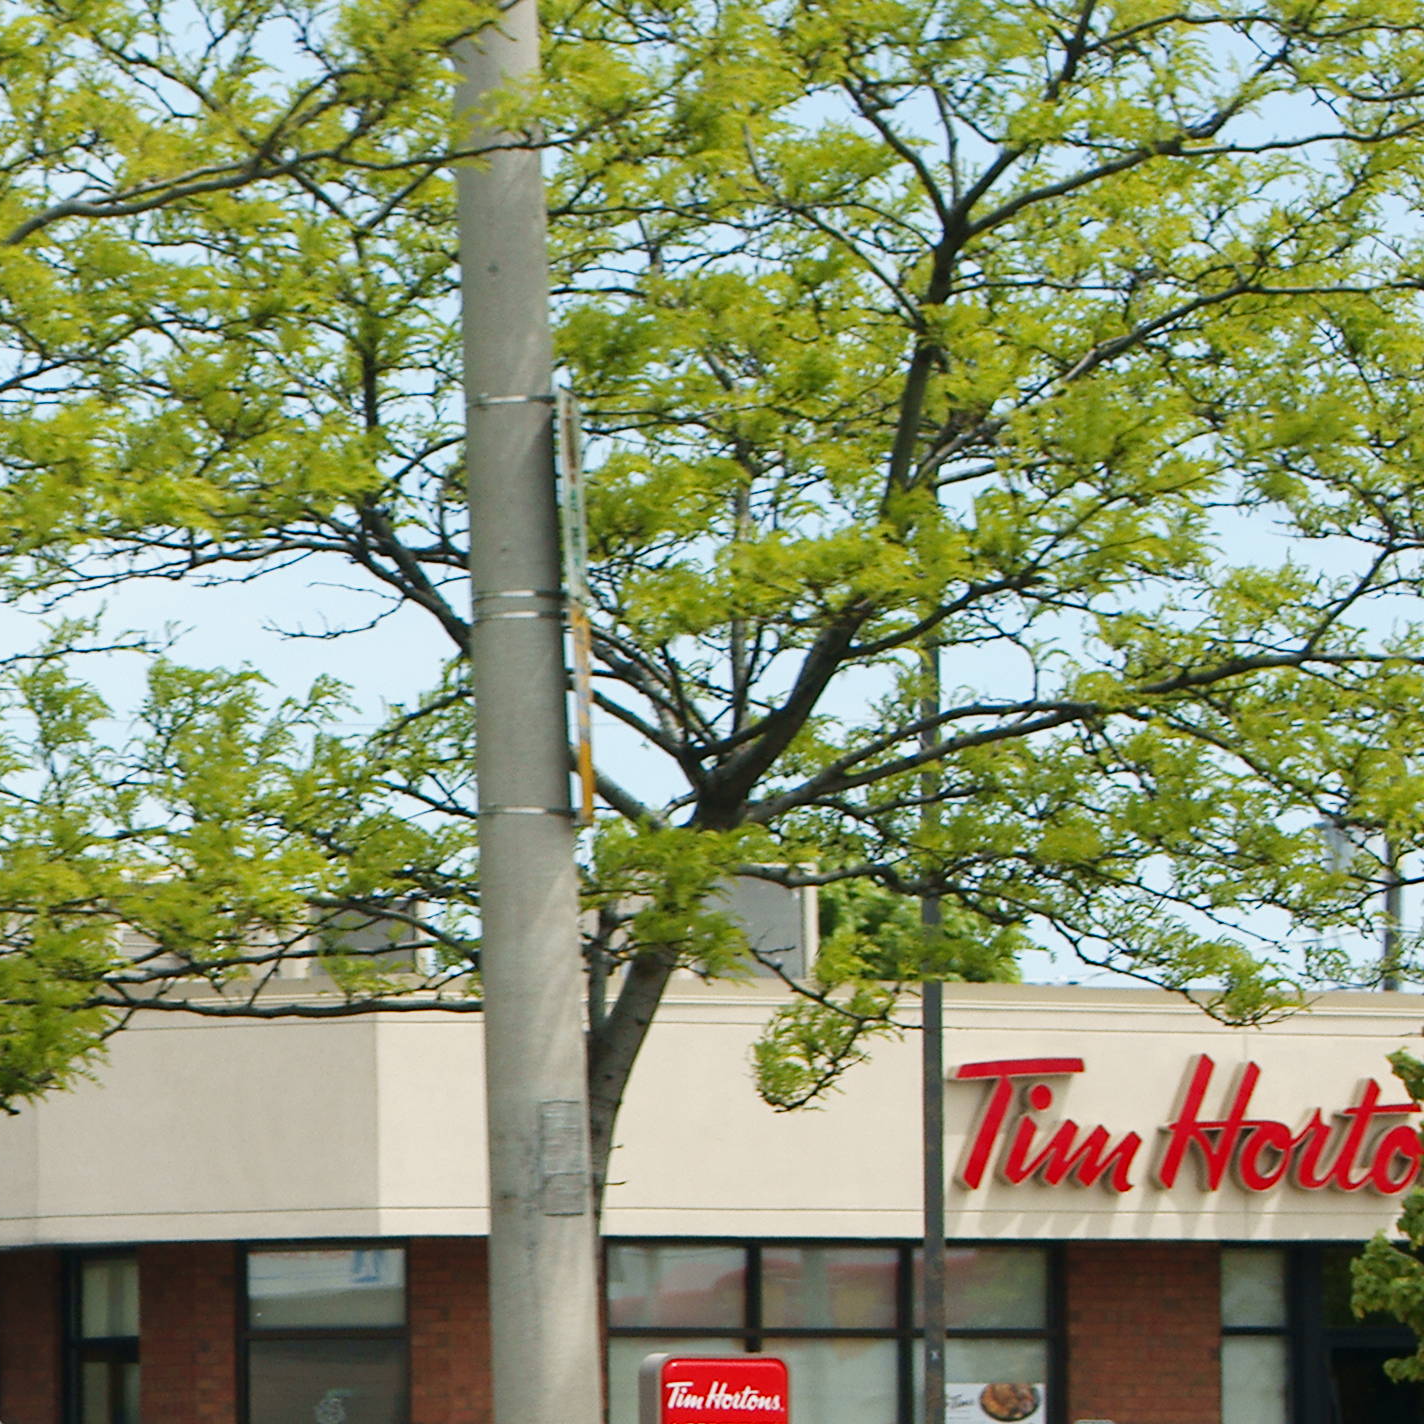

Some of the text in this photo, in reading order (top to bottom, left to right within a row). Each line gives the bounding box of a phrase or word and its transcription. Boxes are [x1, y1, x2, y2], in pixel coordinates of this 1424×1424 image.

[955, 1057, 1142, 1193] Tim
[666, 1380, 781, 1411] Tim Hortons
